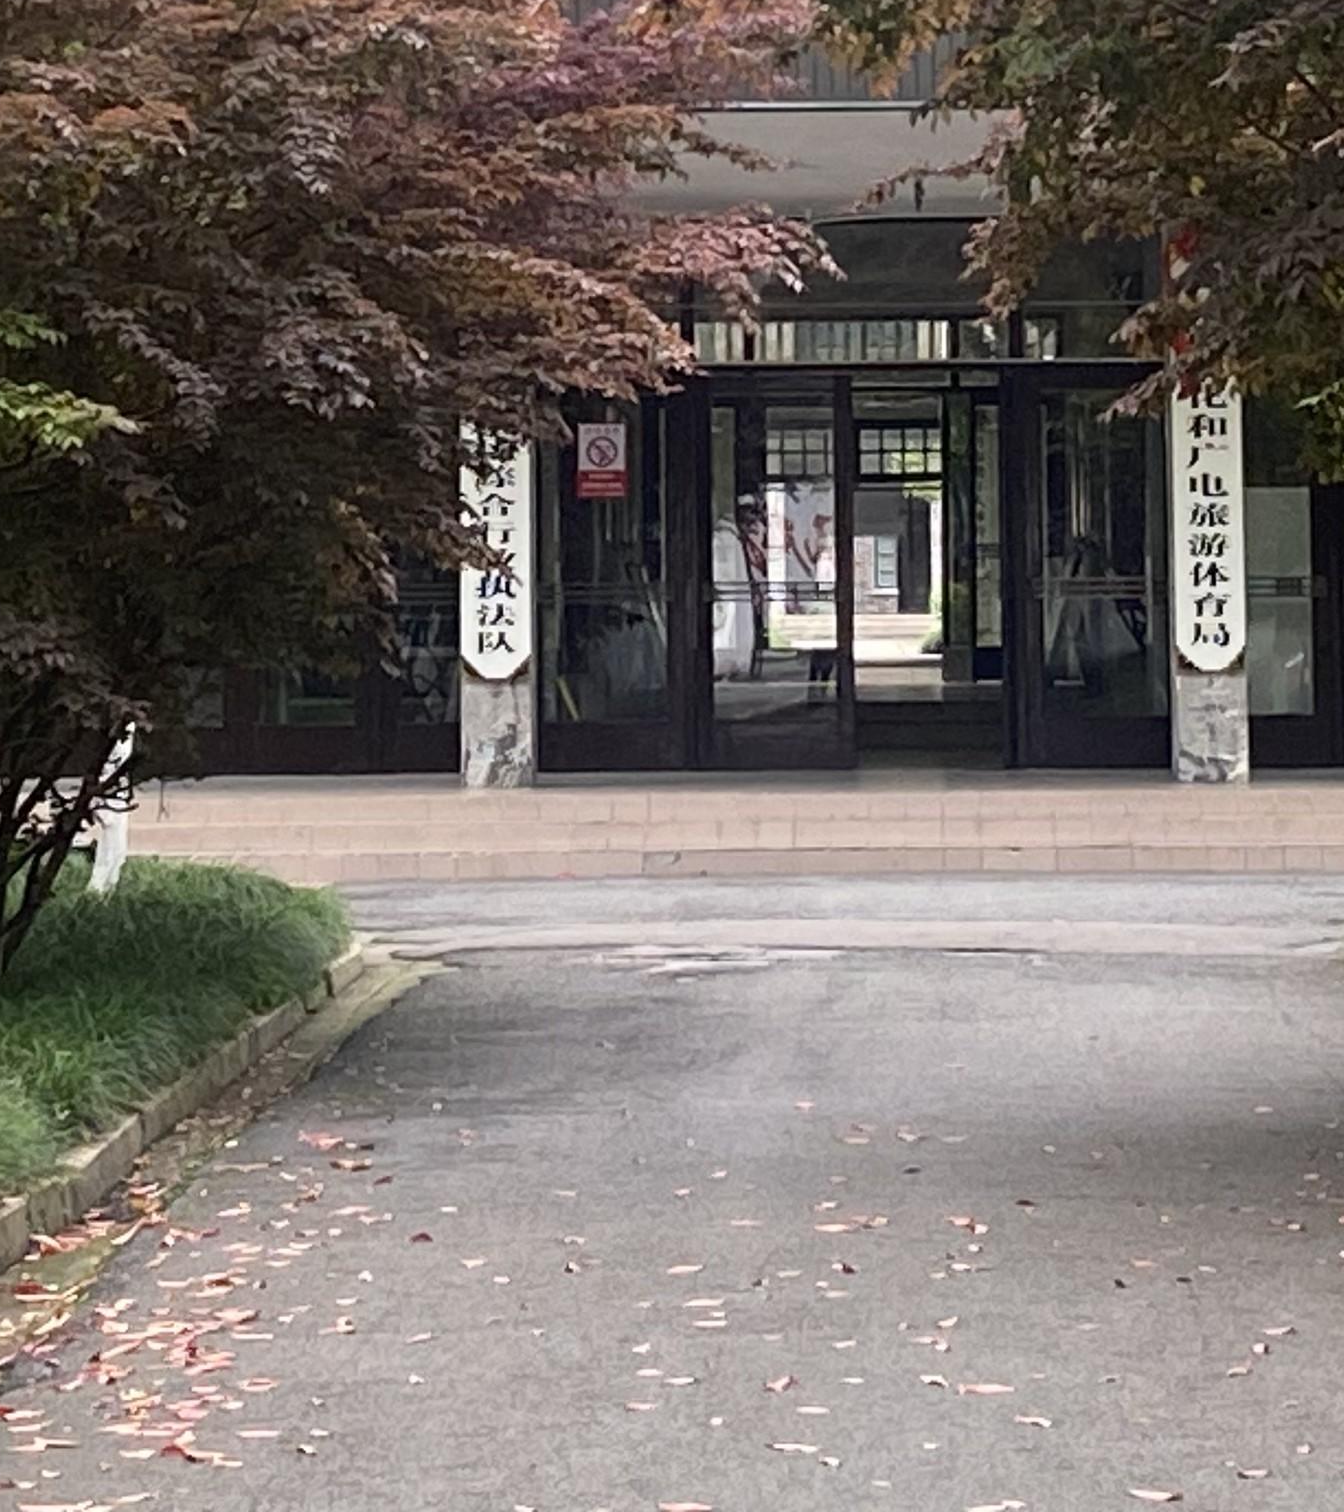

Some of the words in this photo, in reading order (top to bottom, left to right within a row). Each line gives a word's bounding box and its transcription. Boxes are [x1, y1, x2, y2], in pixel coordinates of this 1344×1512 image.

[476, 461, 517, 654] 合行执法队
